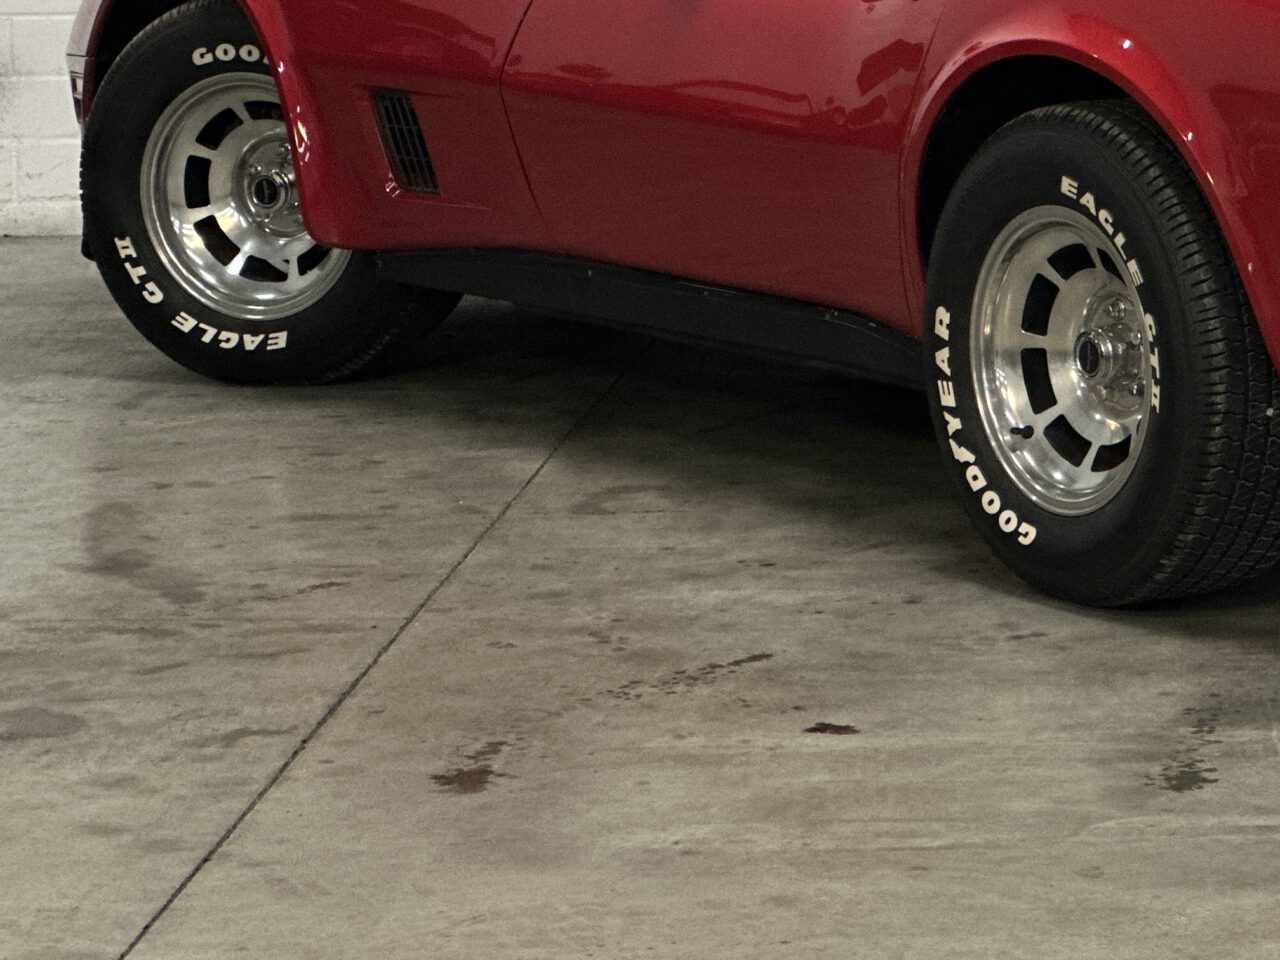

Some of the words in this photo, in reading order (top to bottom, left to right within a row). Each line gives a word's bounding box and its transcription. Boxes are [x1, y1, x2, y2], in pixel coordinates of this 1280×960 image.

[192, 43, 269, 66] GOO
[1060, 175, 1144, 287] EAGLE
[171, 311, 288, 351] EAGLE
[934, 306, 1037, 546] GOODYEAR
